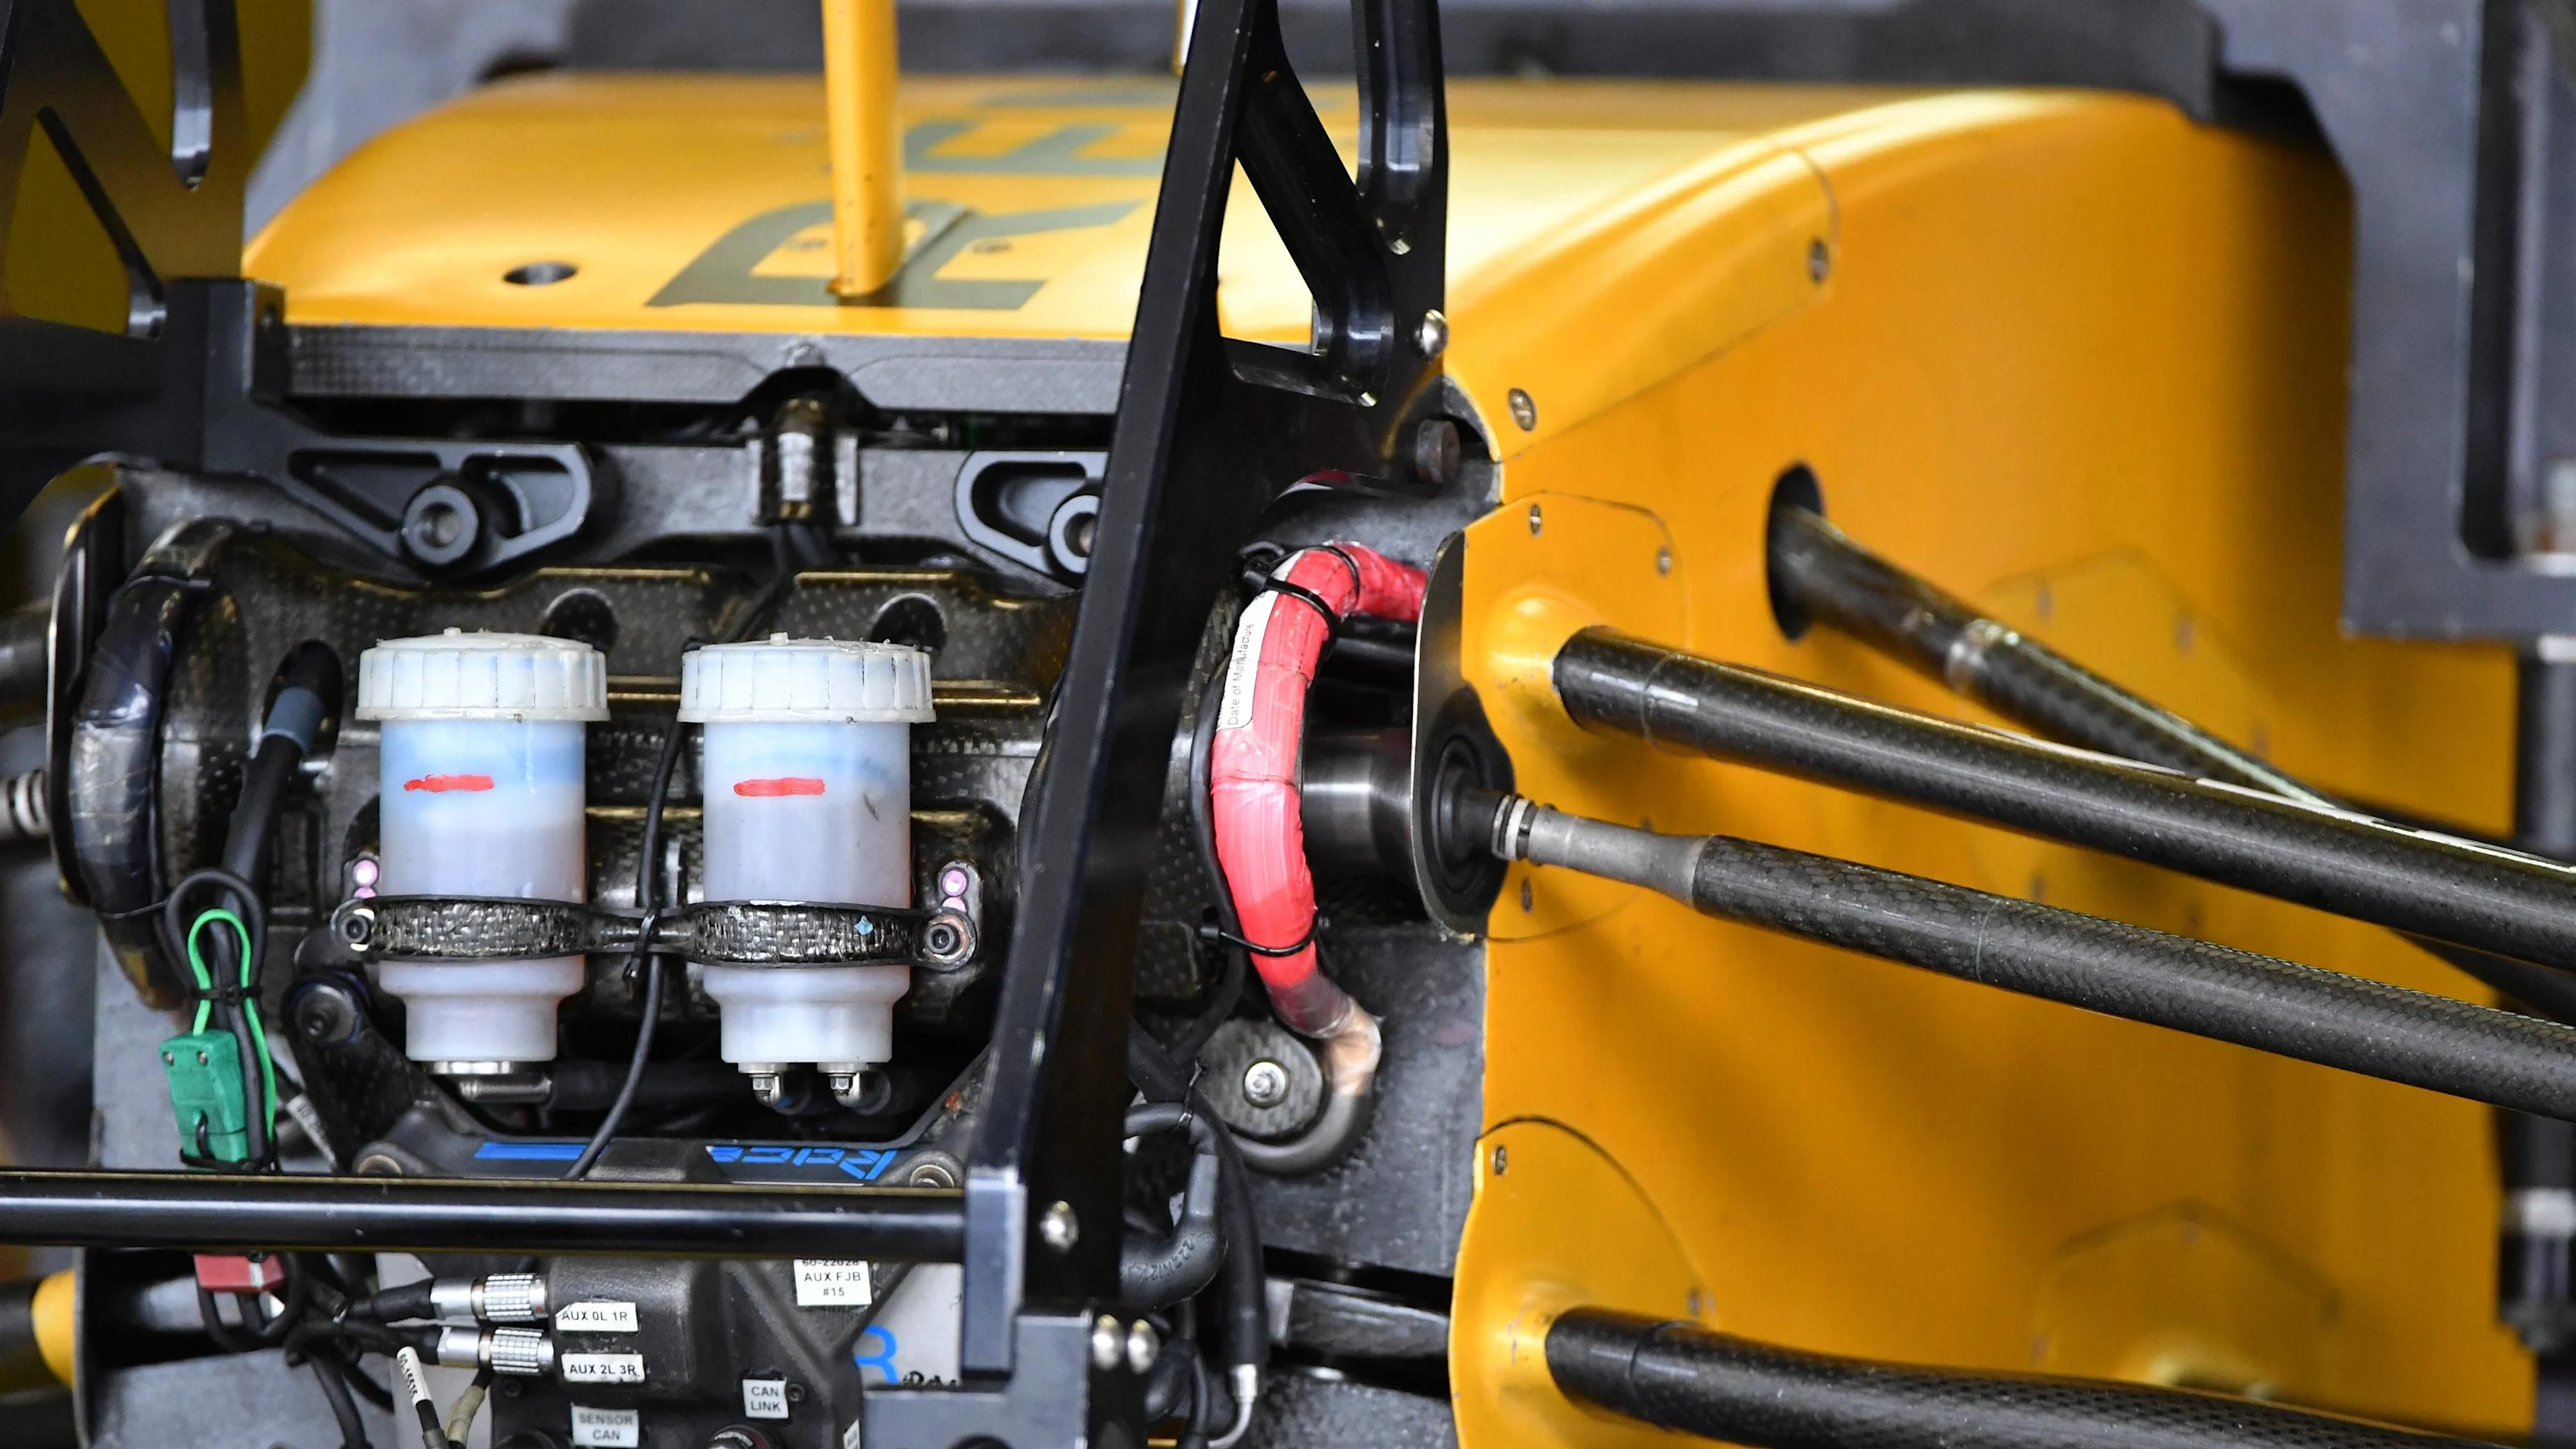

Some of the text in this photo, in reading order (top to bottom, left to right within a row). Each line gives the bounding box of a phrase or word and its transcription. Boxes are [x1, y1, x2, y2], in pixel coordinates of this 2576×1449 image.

[1232, 686, 1241, 695] of
[1228, 699, 1241, 725] Date
[804, 1272, 861, 1282] AUX FJB
[823, 1288, 845, 1296] #15
[562, 1311, 588, 1321] AUX
[612, 1312, 628, 1321] 1R
[569, 1364, 636, 1376] AUX 2L 3R
[751, 1386, 779, 1397] CAN
[751, 1402, 782, 1412] LINK
[579, 1413, 633, 1425] SENSOR
[592, 1429, 621, 1440] CAN
